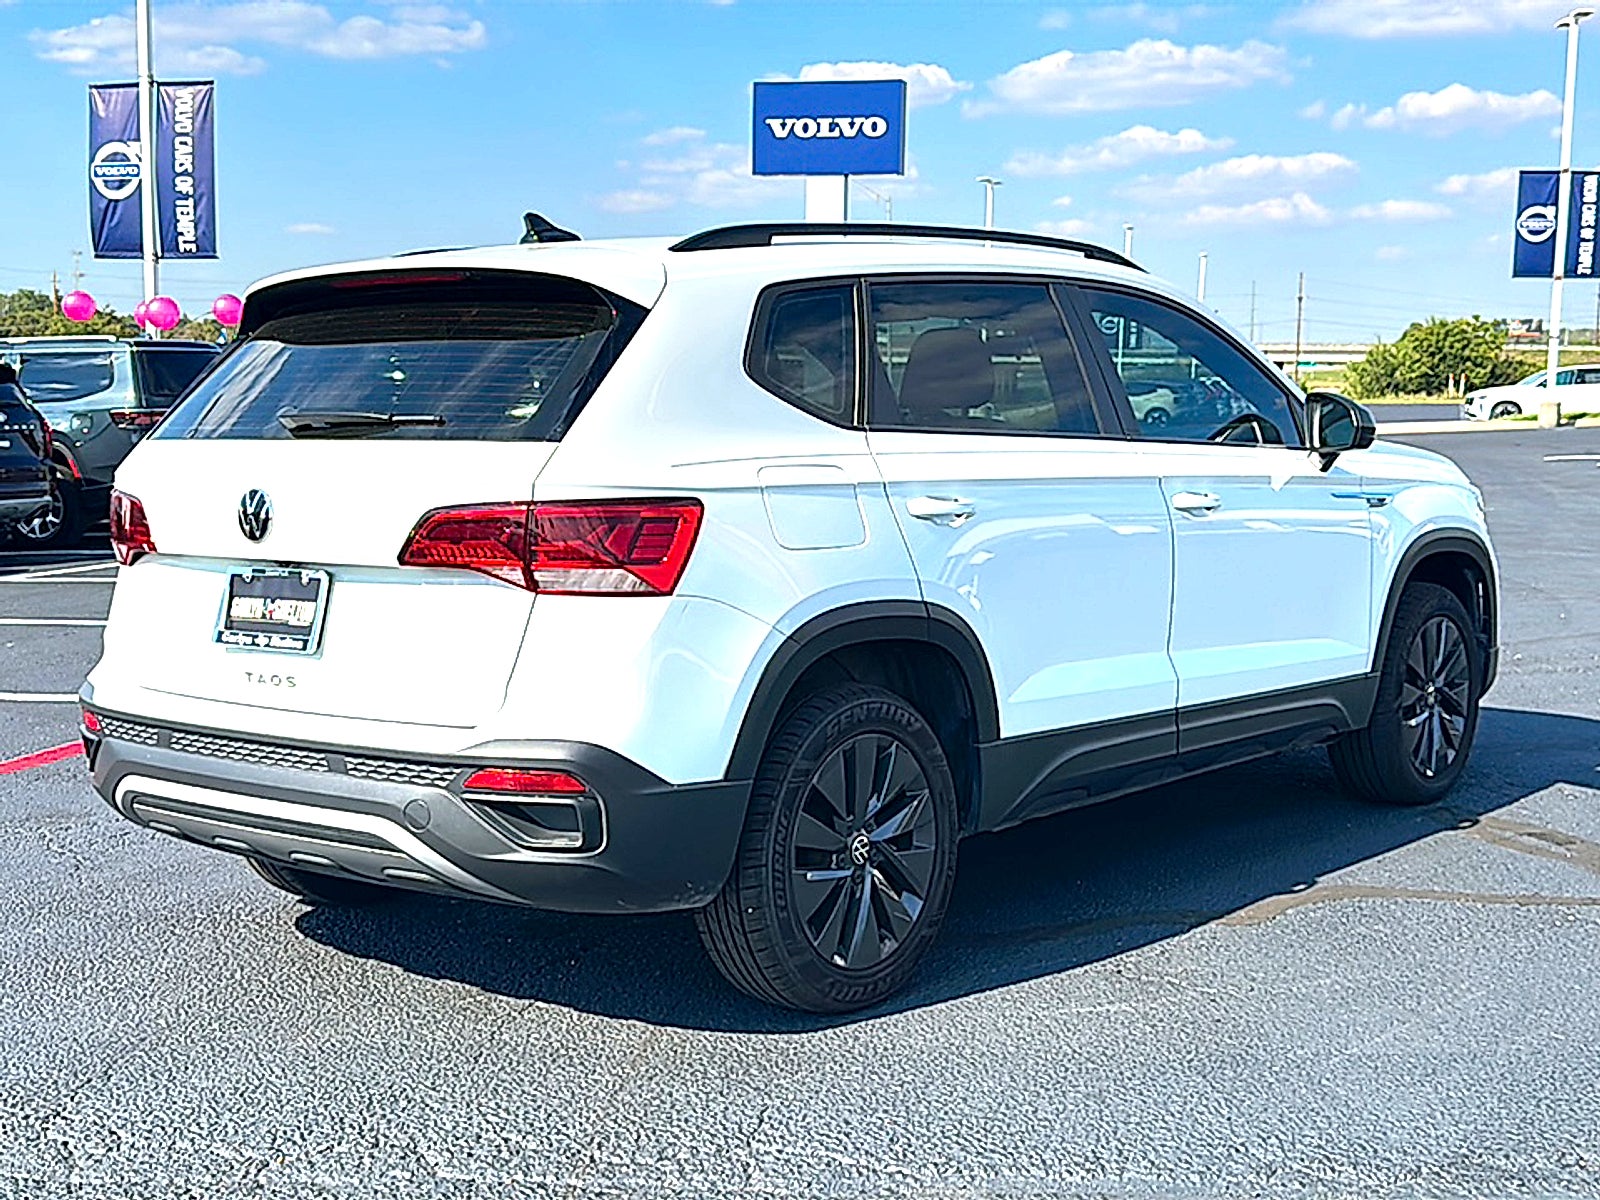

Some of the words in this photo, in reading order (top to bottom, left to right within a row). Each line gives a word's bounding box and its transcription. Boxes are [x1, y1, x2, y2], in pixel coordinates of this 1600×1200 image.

[174, 87, 194, 133] VOLVO
[765, 116, 888, 139] VOLVO
[174, 136, 193, 173] CARS
[94, 165, 139, 176] VOLVO
[174, 176, 194, 195] OF
[174, 197, 197, 253] TEMPLE
[245, 671, 297, 688] TAOS
